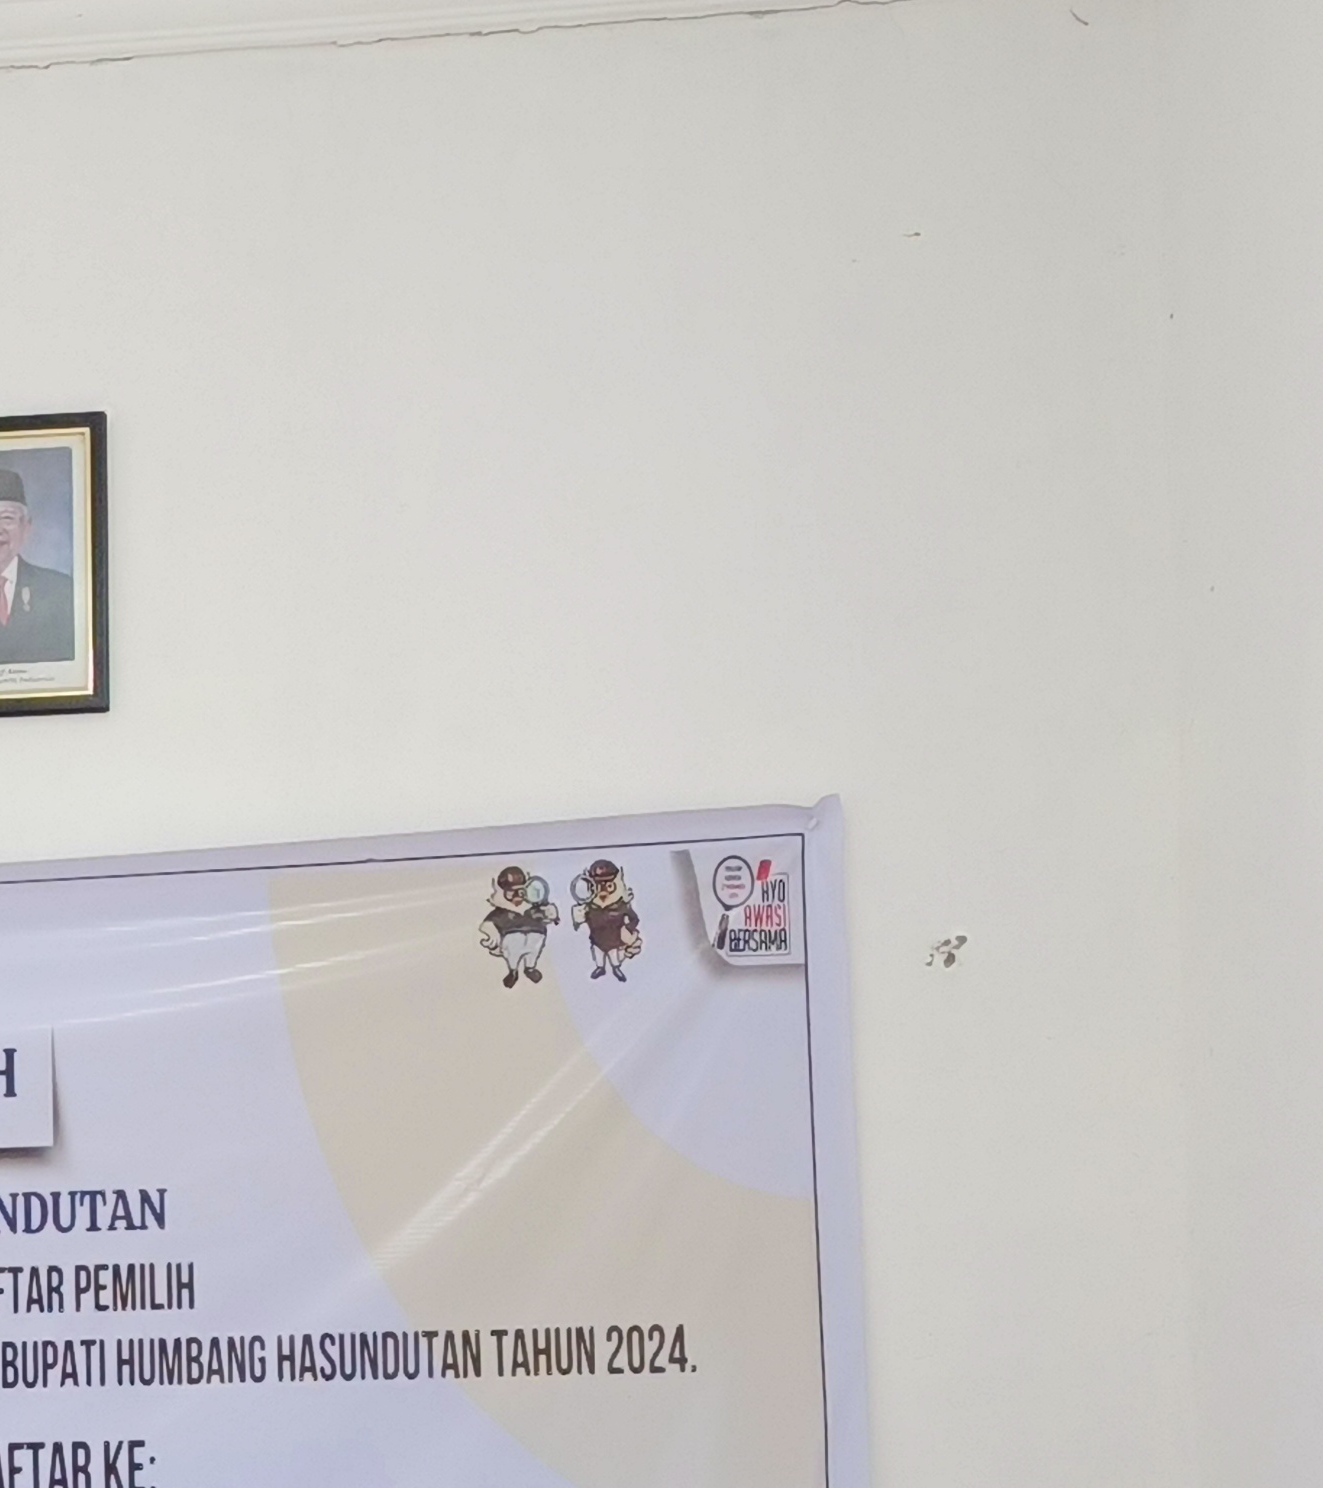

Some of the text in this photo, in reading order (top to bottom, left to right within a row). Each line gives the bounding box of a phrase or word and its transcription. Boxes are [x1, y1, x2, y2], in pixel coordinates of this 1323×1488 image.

[761, 879, 785, 903] AYO
[743, 903, 786, 928] AWASI
[729, 928, 788, 952] BERSAMA
[74, 1261, 195, 1312] PEMILIH
[1, 1338, 105, 1389] BUPATI
[116, 1334, 266, 1386] HUMBANG
[276, 1329, 482, 1383] HASUNDUTAN
[490, 1325, 596, 1378] TAHUN
[605, 1323, 697, 1374] 2024.
